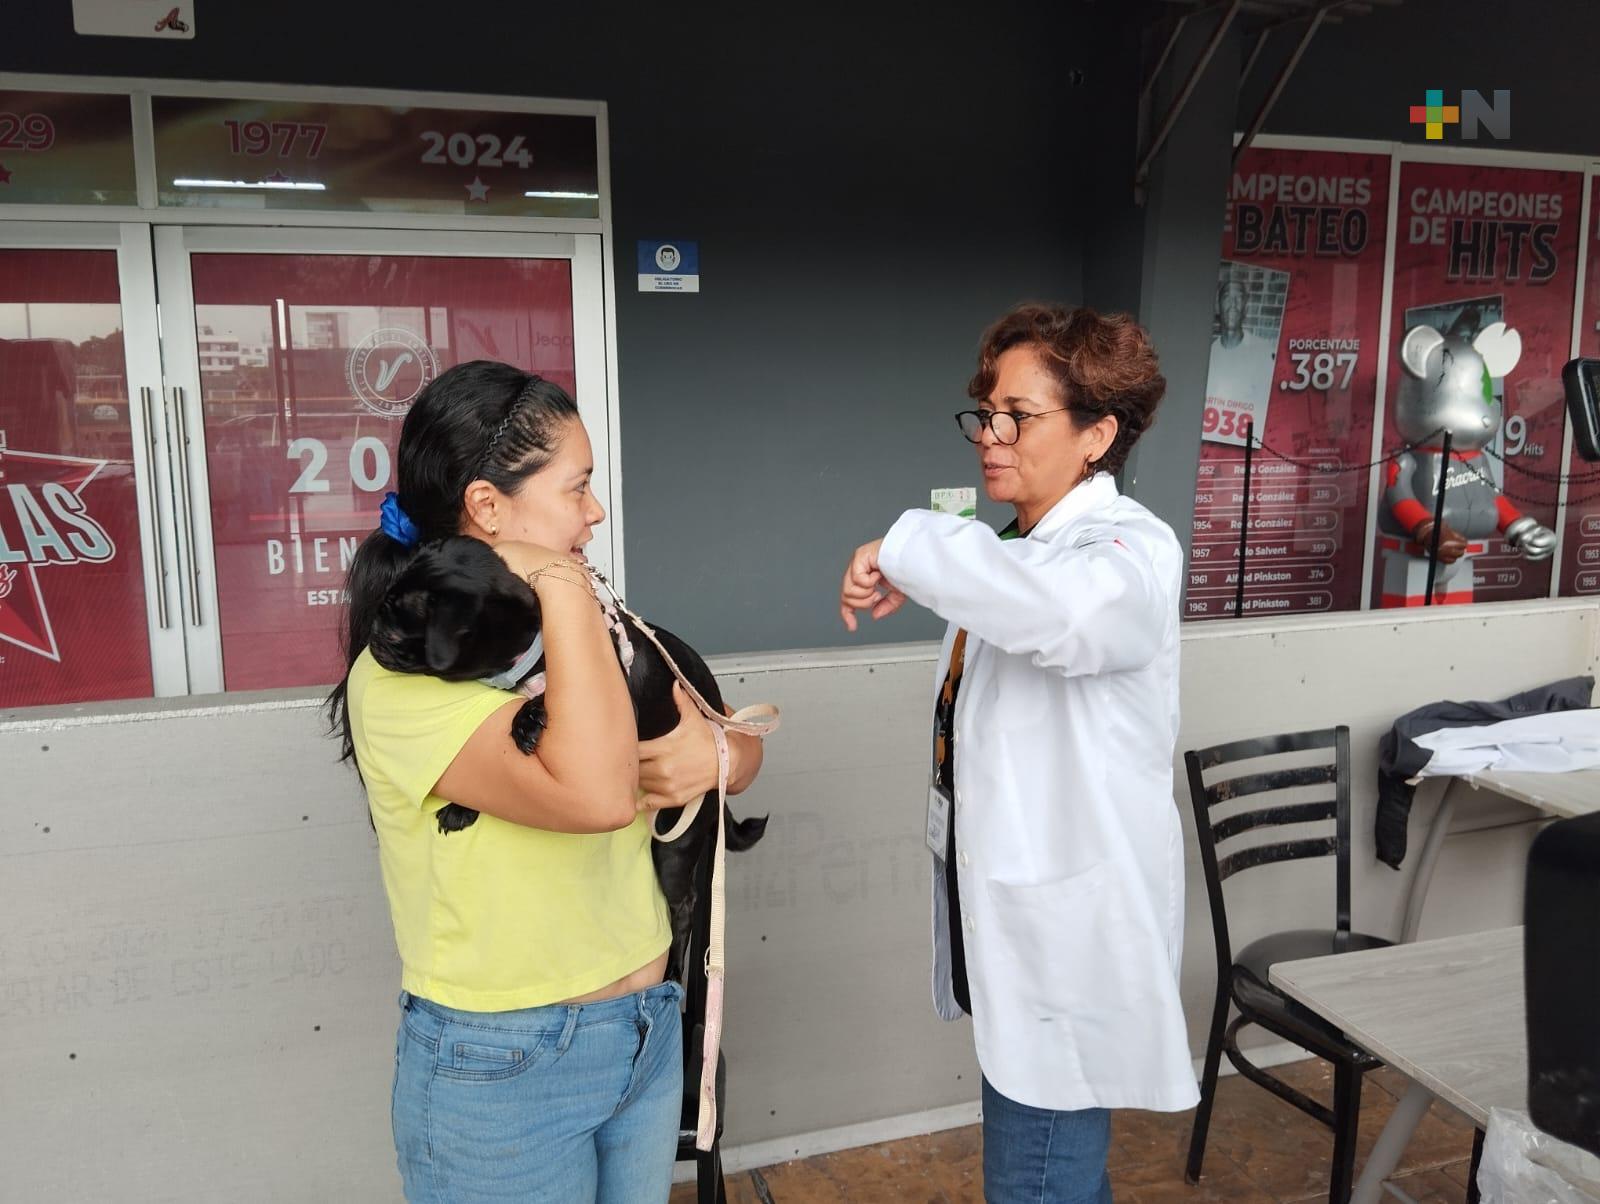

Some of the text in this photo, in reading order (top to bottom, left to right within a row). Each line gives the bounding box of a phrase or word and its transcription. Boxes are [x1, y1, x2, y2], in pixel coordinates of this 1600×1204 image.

[223, 119, 327, 158] 1977
[420, 131, 533, 169] 2024
[1226, 173, 1371, 205] MPEONES
[1410, 188, 1562, 220] CAMPEONES
[1235, 203, 1368, 255] BATEO
[1409, 216, 1447, 245] DE
[1448, 219, 1559, 281] HITS
[1289, 338, 1361, 351] PORCENTAJE
[1280, 353, 1357, 391] .387
[1524, 444, 1544, 456] Hits
[1258, 464, 1297, 474] González
[1256, 491, 1295, 502] González
[1193, 520, 1211, 530] 1954
[1254, 518, 1292, 528] González
[1192, 548, 1210, 558] 1957
[1256, 546, 1287, 556] Salvent
[1191, 575, 1208, 584] 1961
[1254, 572, 1292, 582] Pinkston
[1189, 603, 1208, 612] 1962
[1252, 599, 1290, 610] Pinkston
